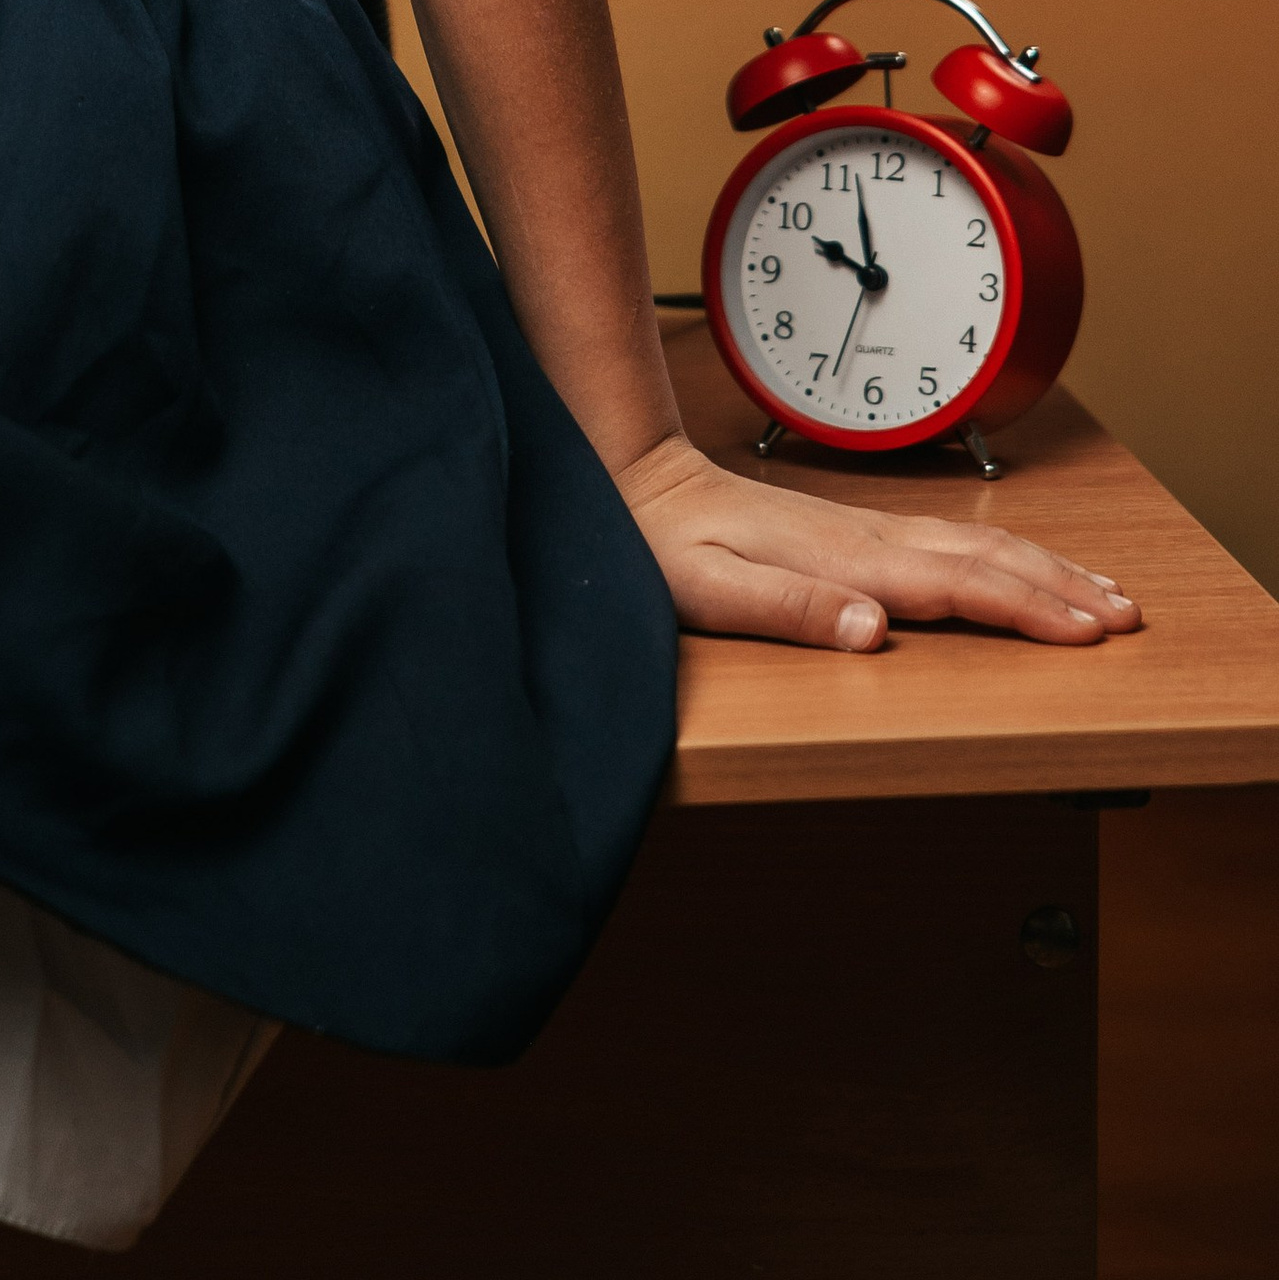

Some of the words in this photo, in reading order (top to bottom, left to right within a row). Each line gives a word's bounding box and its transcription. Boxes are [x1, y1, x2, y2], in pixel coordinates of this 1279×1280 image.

[821, 162, 851, 192] 11
[870, 151, 906, 182] 12
[931, 169, 945, 198] 1
[777, 201, 813, 231] 10
[966, 218, 987, 249] 2
[760, 254, 782, 284] 9
[978, 272, 1000, 303] 3
[773, 310, 794, 340] 8
[958, 325, 978, 354] 4
[854, 343, 895, 356] QUARTZ
[808, 352, 829, 382] 7
[917, 366, 938, 396] 5
[862, 376, 884, 406] 6
